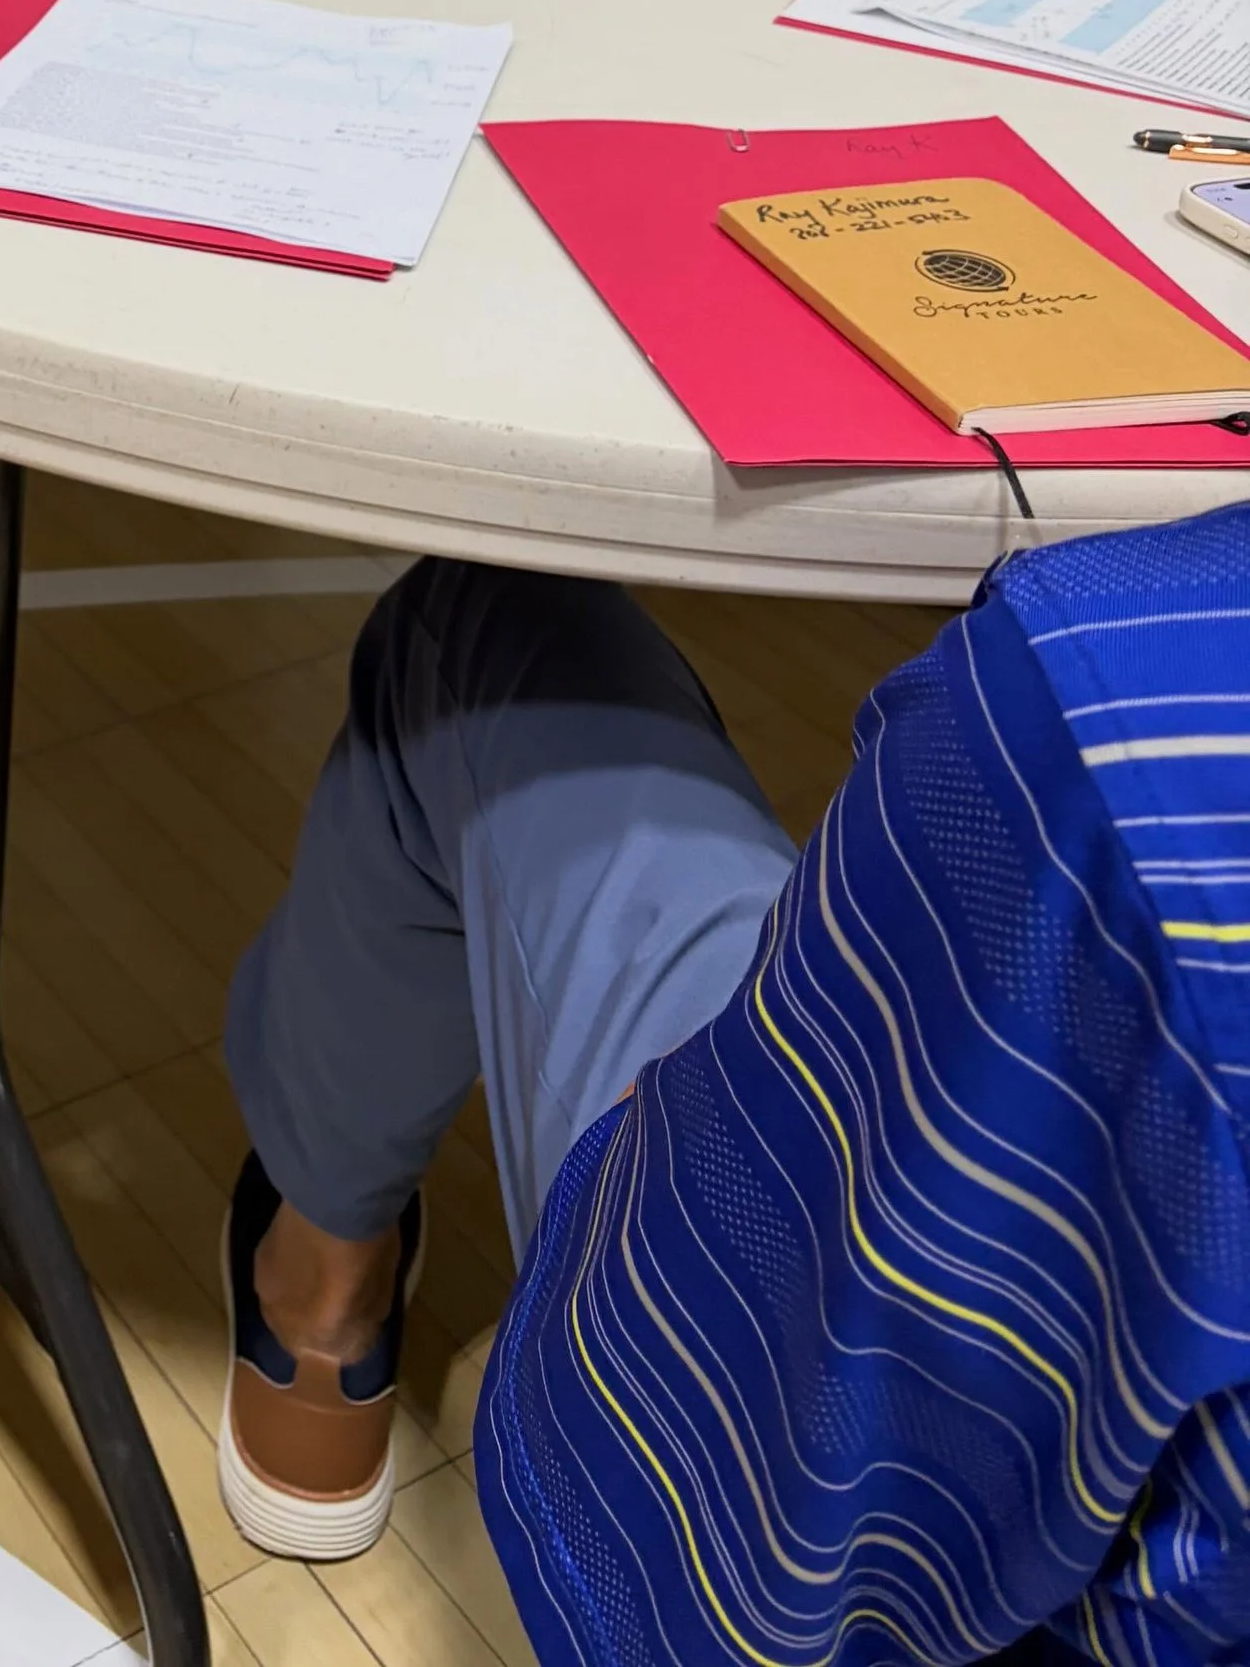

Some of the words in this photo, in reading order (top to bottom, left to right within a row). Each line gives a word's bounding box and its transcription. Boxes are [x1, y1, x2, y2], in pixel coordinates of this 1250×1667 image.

[756, 204, 821, 225] Ray
[819, 195, 950, 219] Kajimura
[913, 291, 1098, 318] Signature
[976, 306, 1063, 319] TOURS
